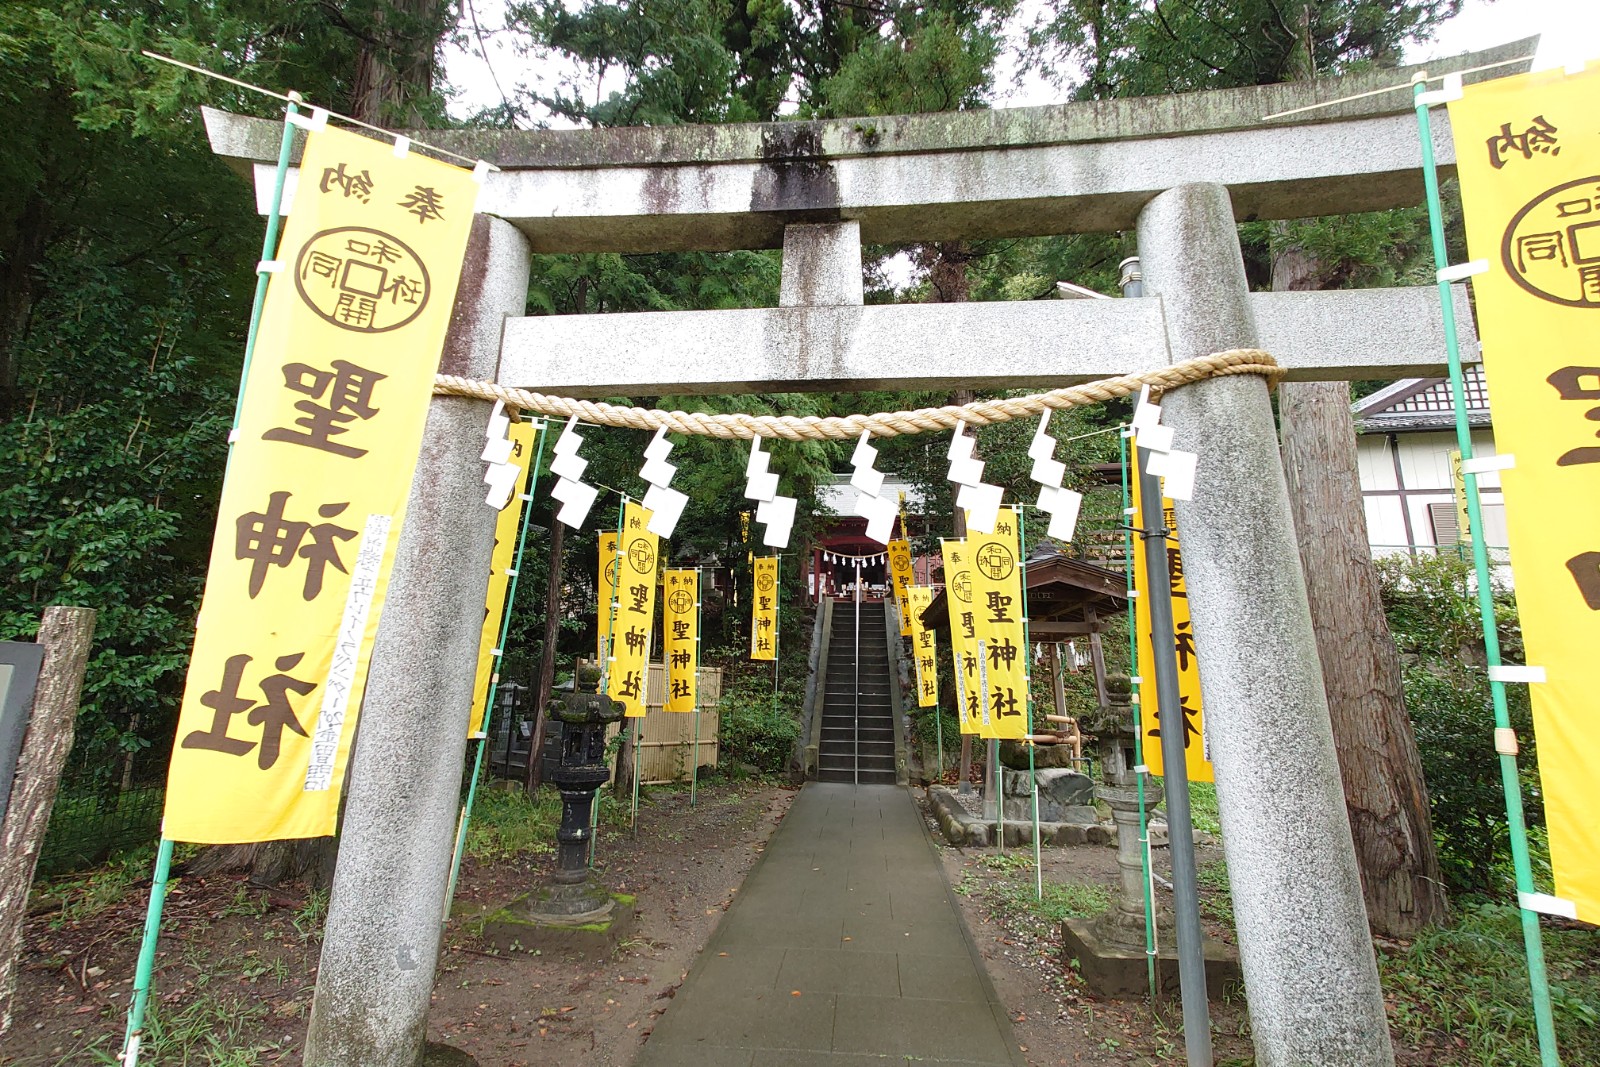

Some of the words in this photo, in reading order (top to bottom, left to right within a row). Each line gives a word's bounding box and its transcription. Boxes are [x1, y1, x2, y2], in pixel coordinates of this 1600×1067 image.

[669, 576, 693, 586] 奉納
[757, 596, 772, 651] 聖神社
[986, 591, 1022, 720] 聖神社
[670, 620, 692, 700] 聖神社
[919, 631, 936, 697] 聖神社
